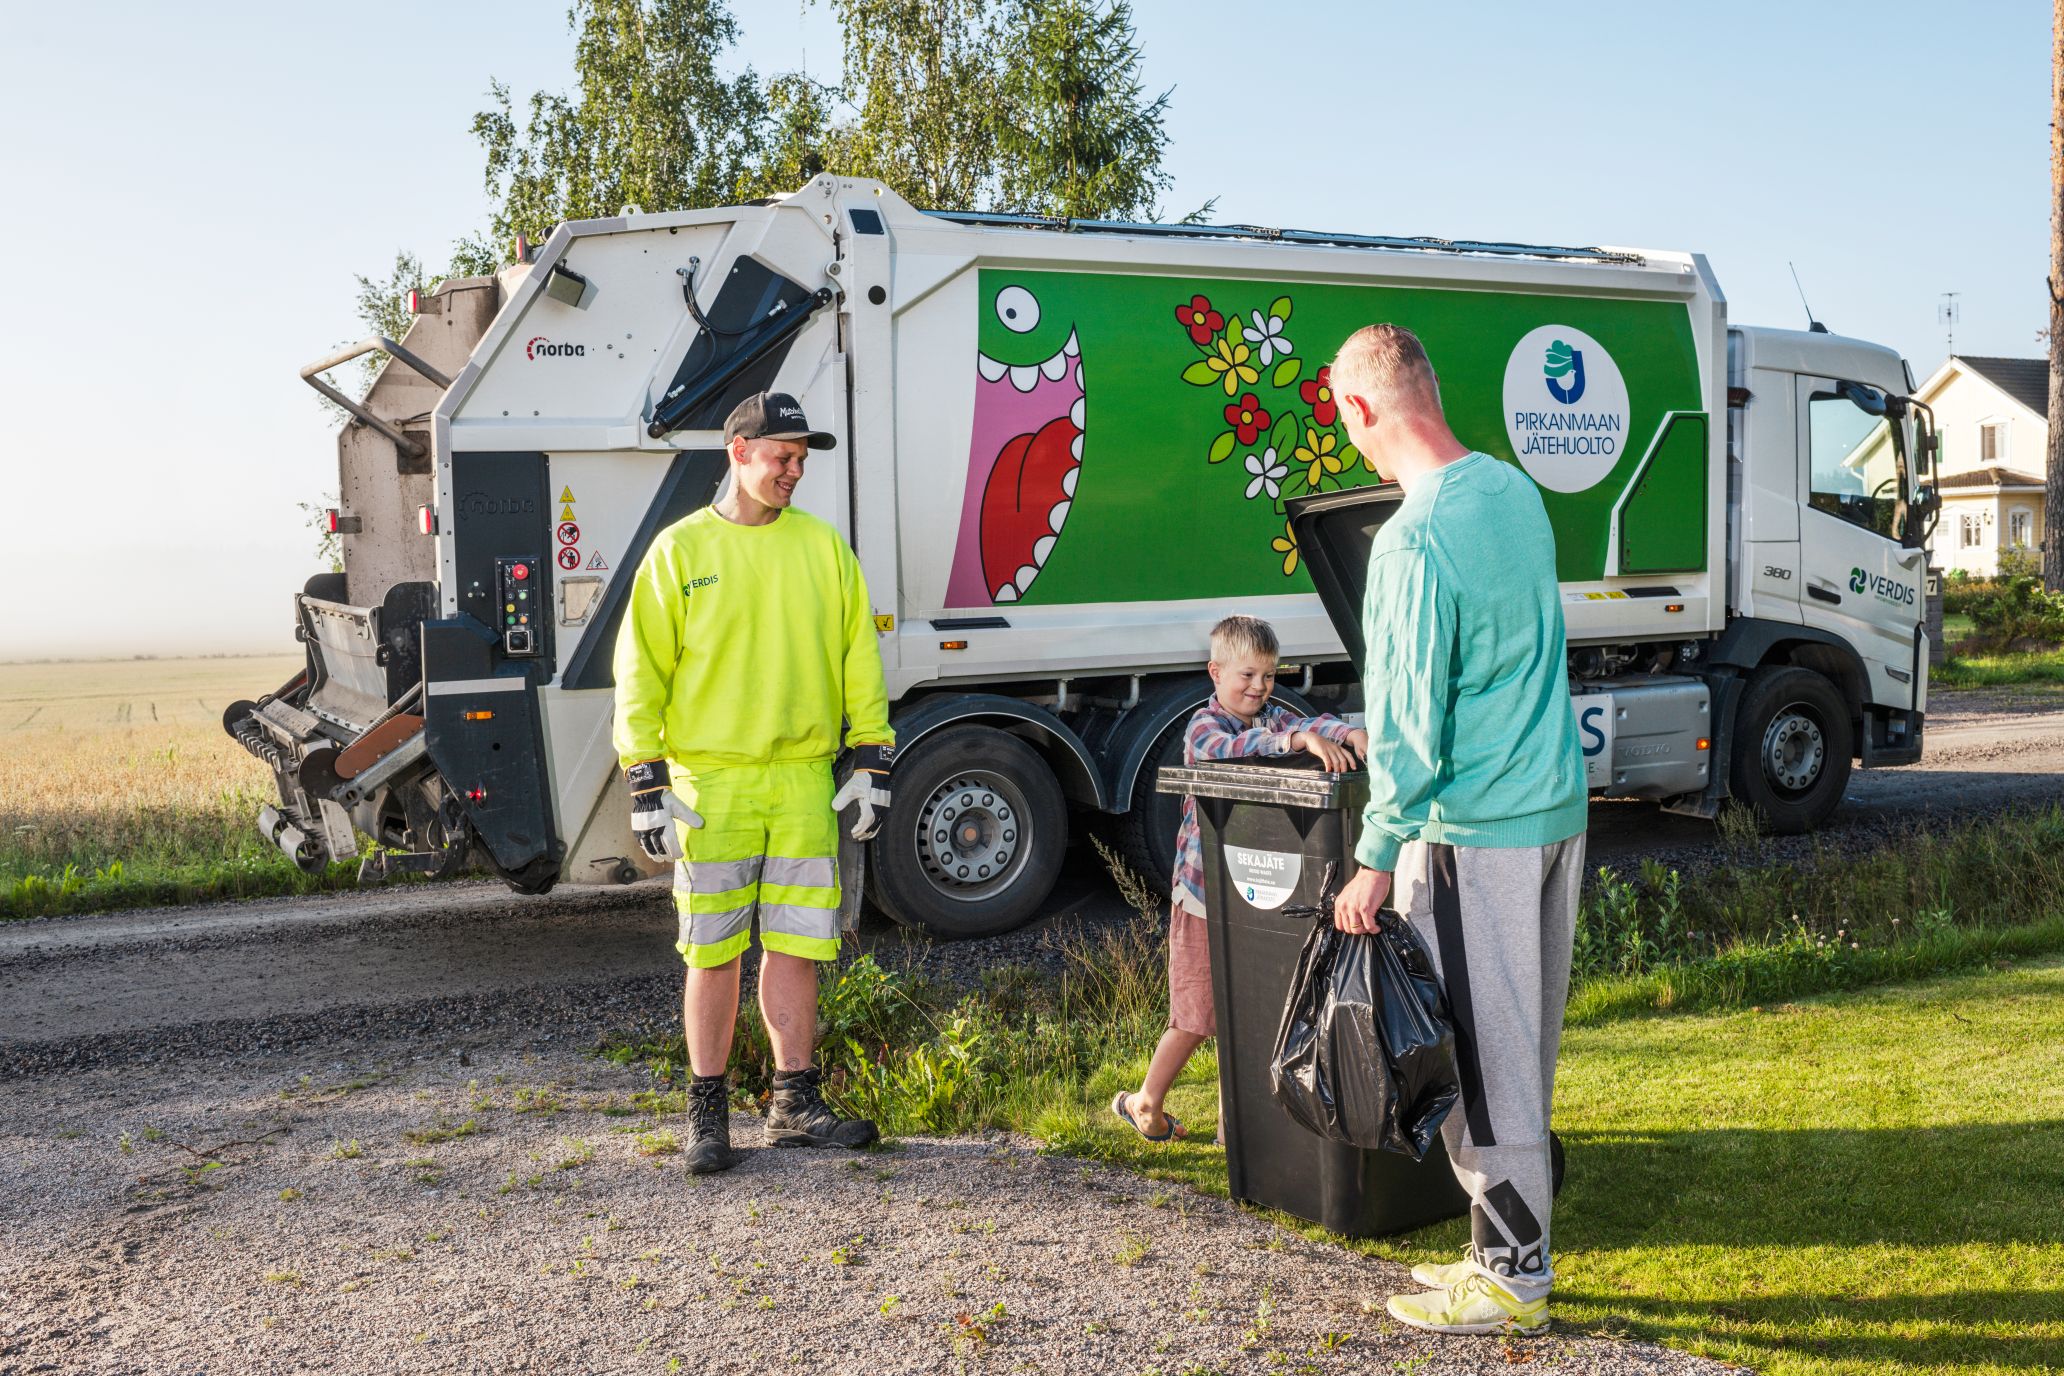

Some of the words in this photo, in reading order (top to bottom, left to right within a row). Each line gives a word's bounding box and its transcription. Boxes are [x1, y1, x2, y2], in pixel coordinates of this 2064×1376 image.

[536, 342, 585, 357] norba
[1515, 412, 1620, 432] PIRKANMAAN
[1521, 432, 1615, 455] JÄTEHUOLTO
[1763, 565, 1792, 580] 380
[1869, 572, 1916, 606] VERDIS
[1581, 707, 1605, 756] S
[1237, 852, 1285, 870] SEKAJÄTE
